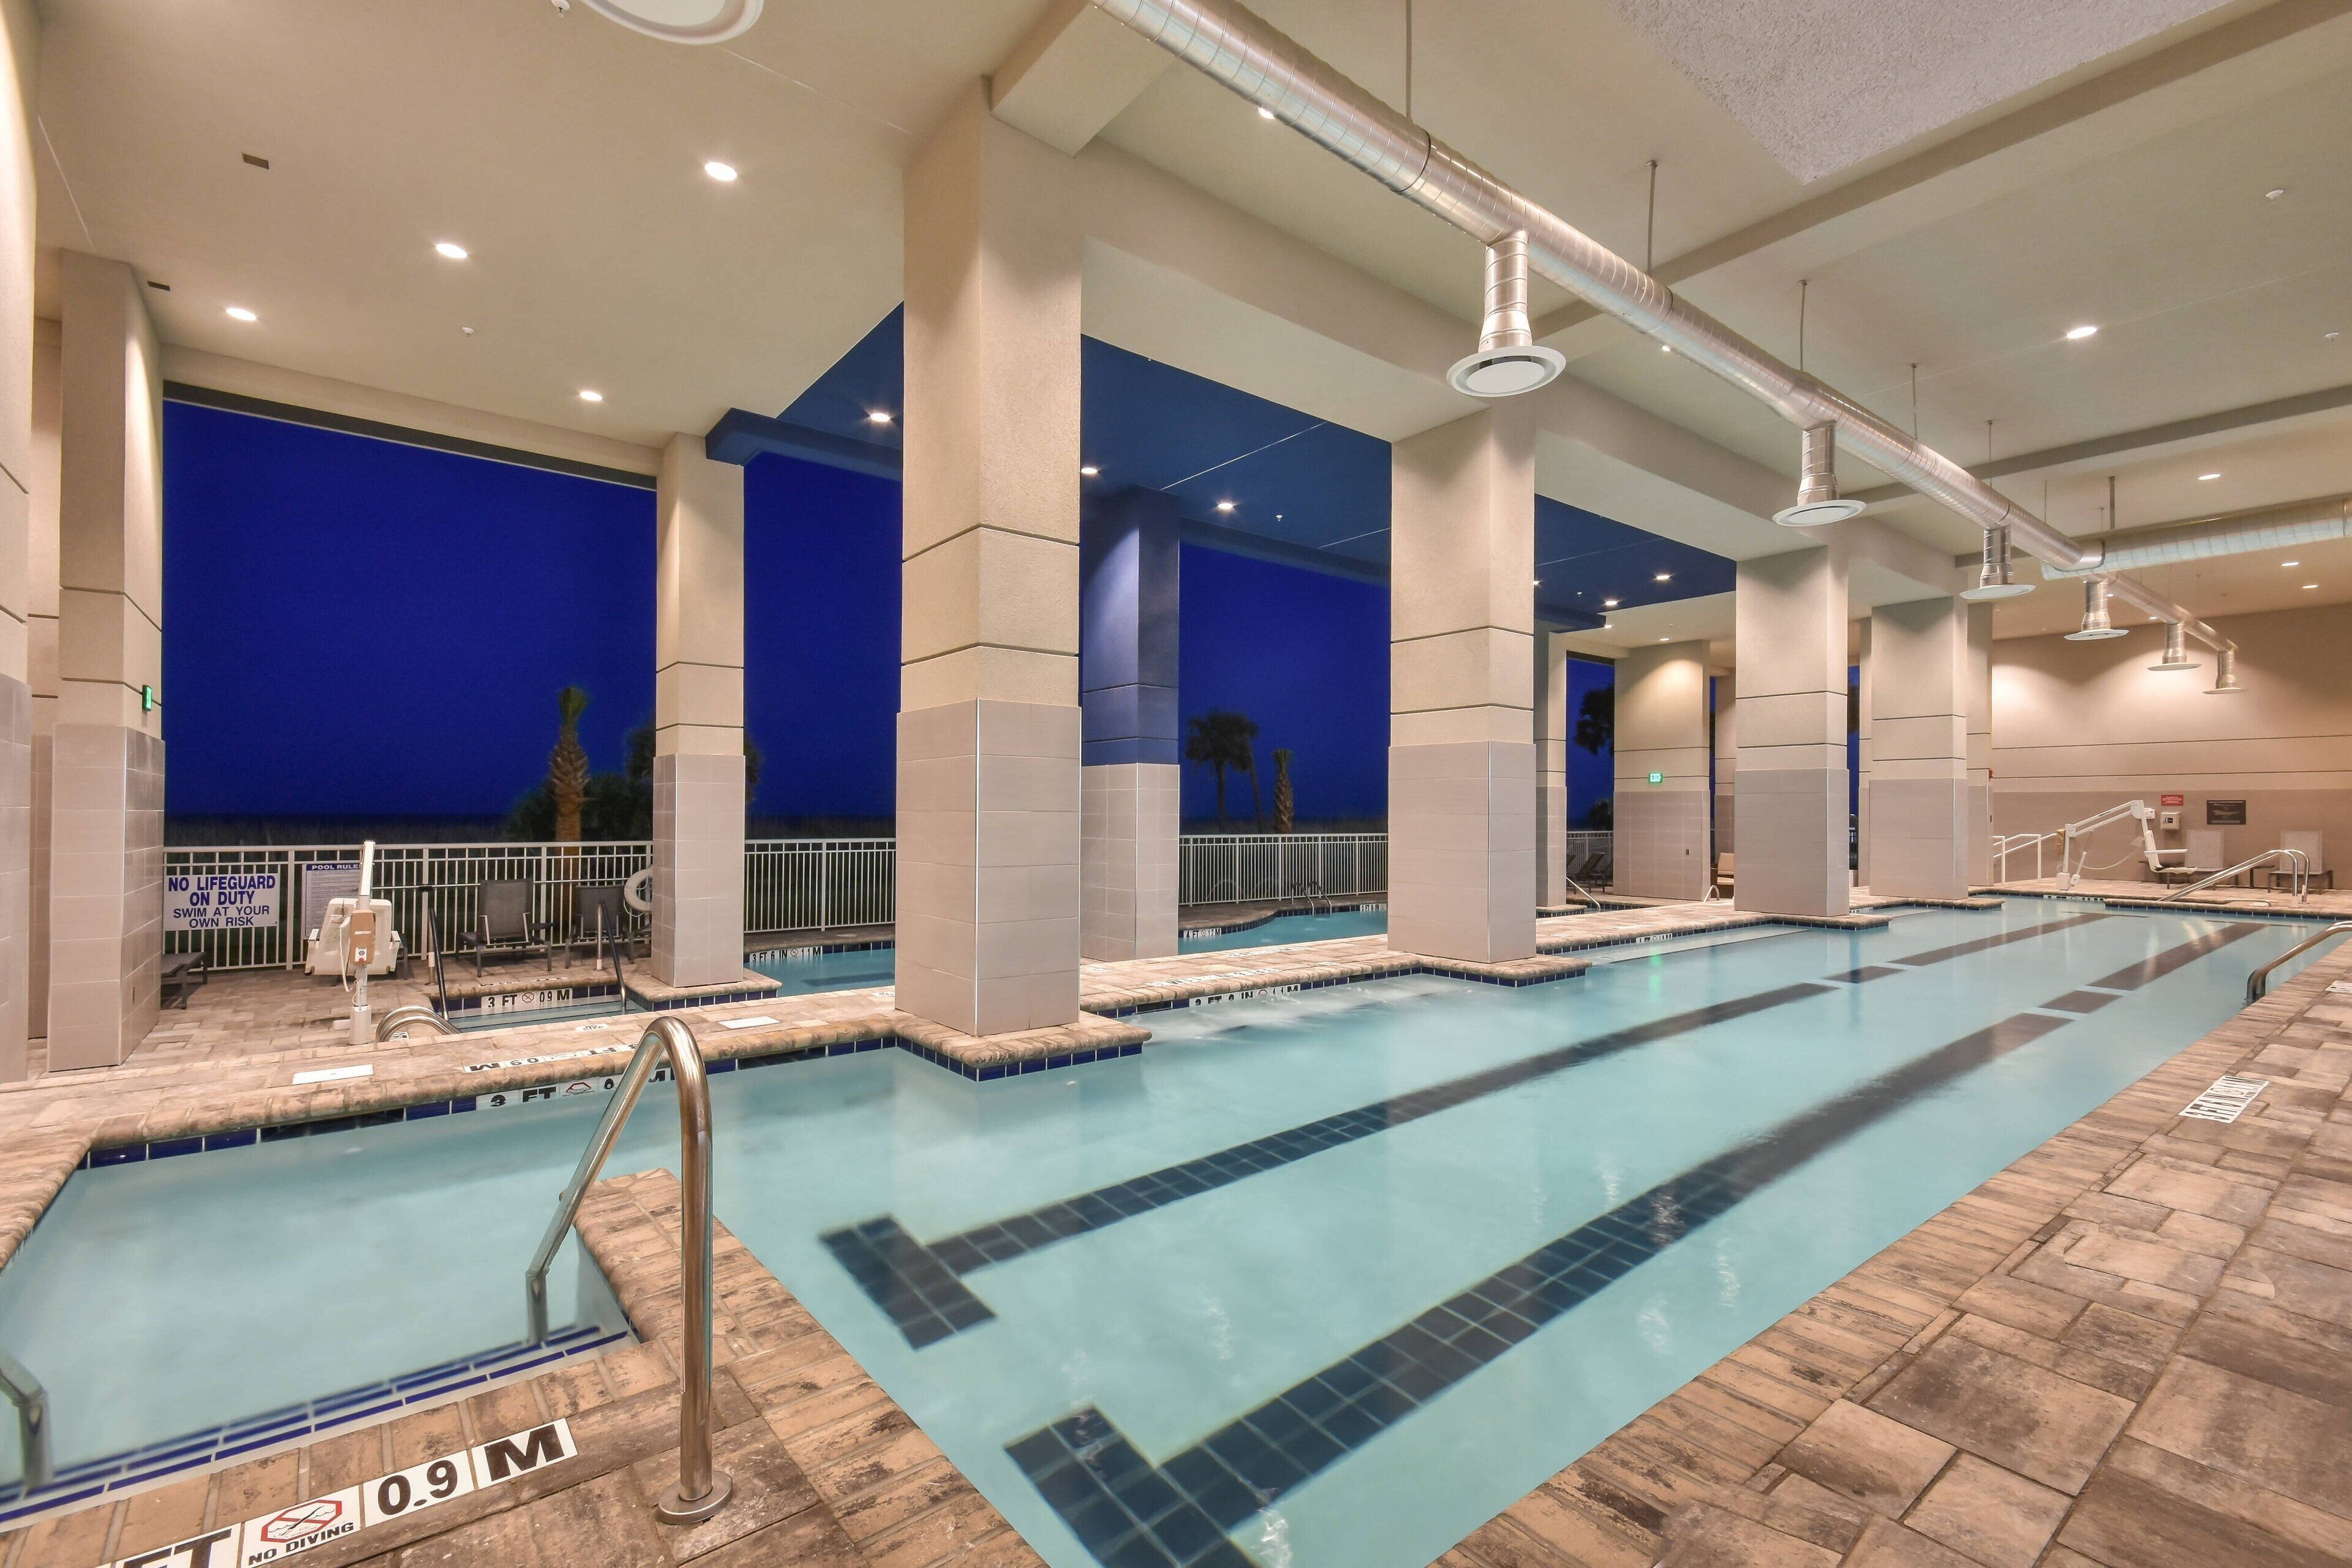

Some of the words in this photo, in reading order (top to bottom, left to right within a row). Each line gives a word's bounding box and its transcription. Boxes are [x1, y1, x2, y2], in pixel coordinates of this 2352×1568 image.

[168, 876, 189, 892] NO
[197, 875, 276, 891] LIFEGUARD
[190, 891, 209, 907] ON
[218, 890, 255, 905] DUTY
[173, 907, 207, 919] SWIM
[213, 907, 230, 917] AT
[236, 905, 270, 916] YOUR
[189, 917, 219, 929] OWN
[225, 916, 254, 927] RISK
[753, 954, 756, 962] 3
[760, 952, 767, 961] FT
[779, 949, 788, 958] IN
[813, 946, 821, 955] M
[488, 997, 495, 1008] 3
[502, 994, 518, 1006] FT
[557, 989, 570, 1001] M
[1208, 995, 1222, 1004] FT
[1241, 990, 1253, 999] IN
[588, 1047, 617, 1056] FT
[469, 1062, 501, 1071] M
[490, 1094, 507, 1107] 3
[522, 1086, 557, 1102] FT
[2189, 1103, 2237, 1116] FT
[377, 1460, 458, 1515] 0.9
[484, 1423, 565, 1482] M
[248, 1548, 277, 1566] NO
[285, 1522, 354, 1553] DIVING
